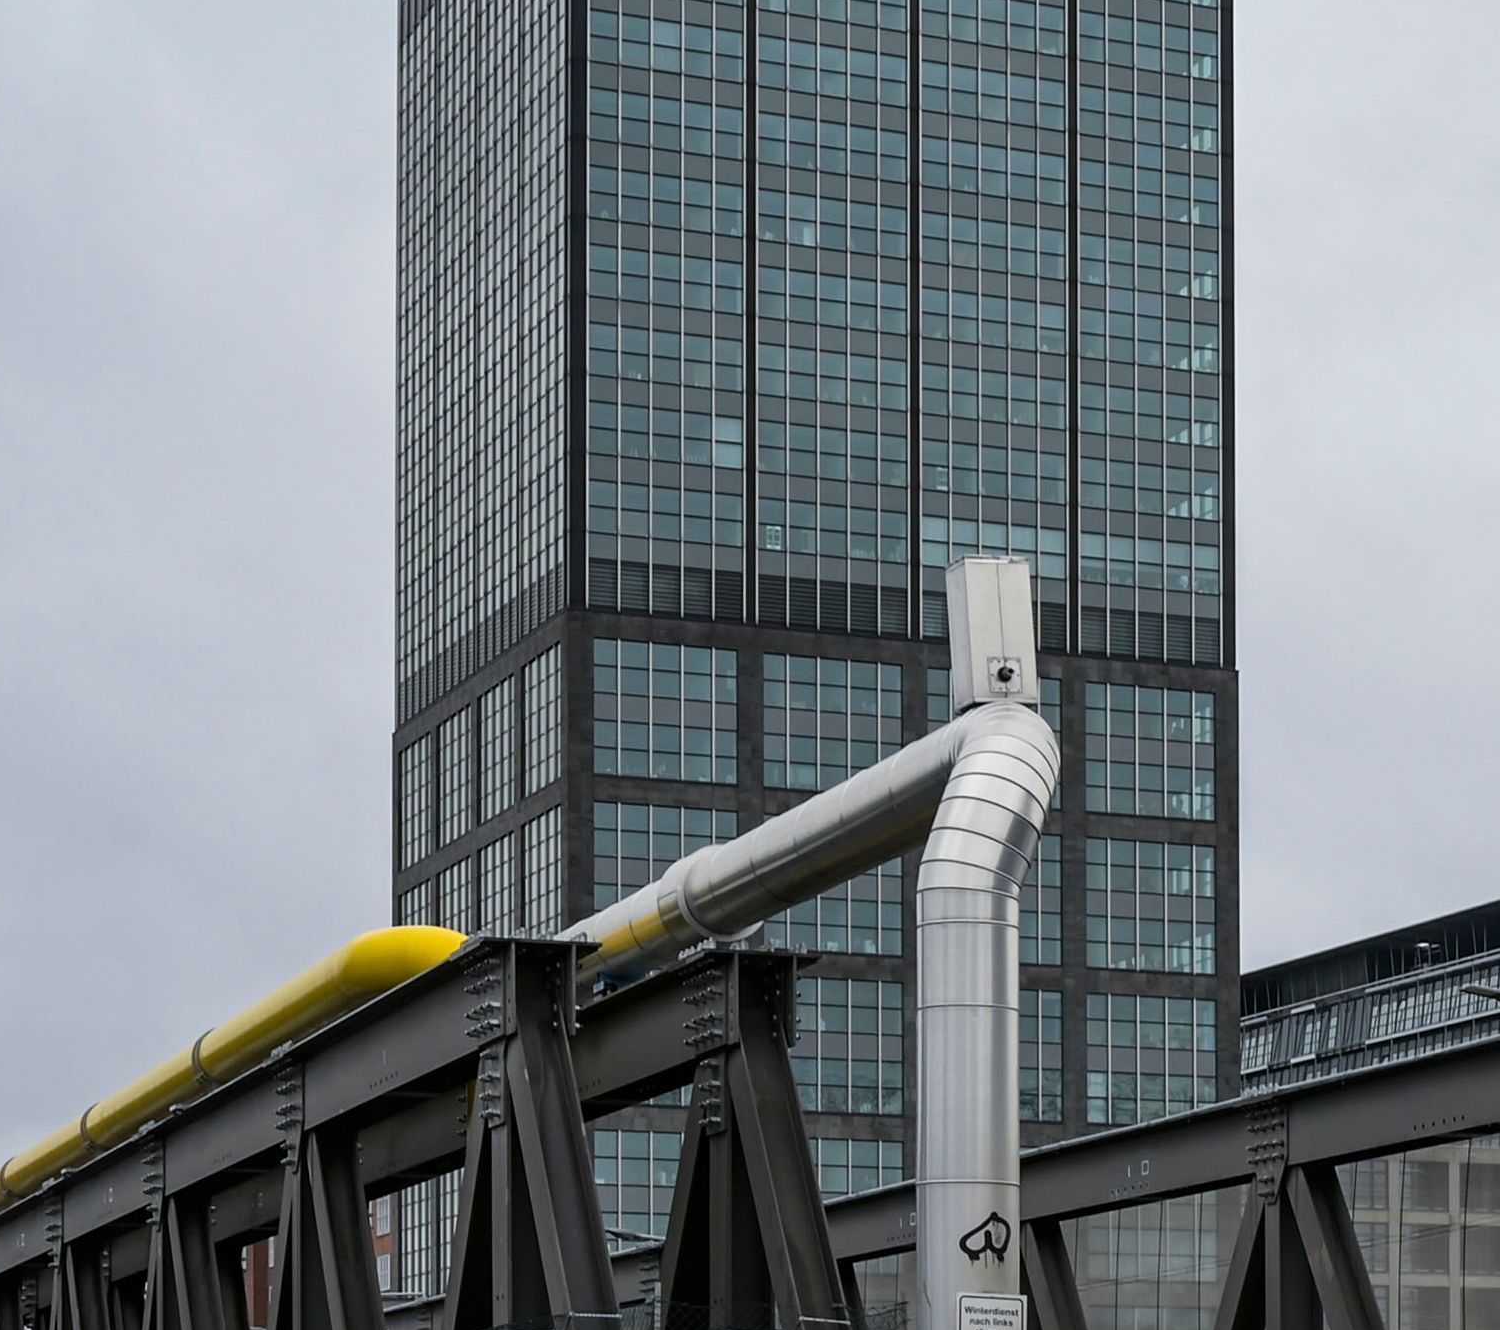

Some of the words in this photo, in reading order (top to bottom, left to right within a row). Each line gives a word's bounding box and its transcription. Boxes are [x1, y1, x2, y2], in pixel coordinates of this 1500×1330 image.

[964, 1305, 1019, 1317] Winterdienst
[969, 1318, 991, 1326] nach
[992, 1318, 1013, 1327] links
